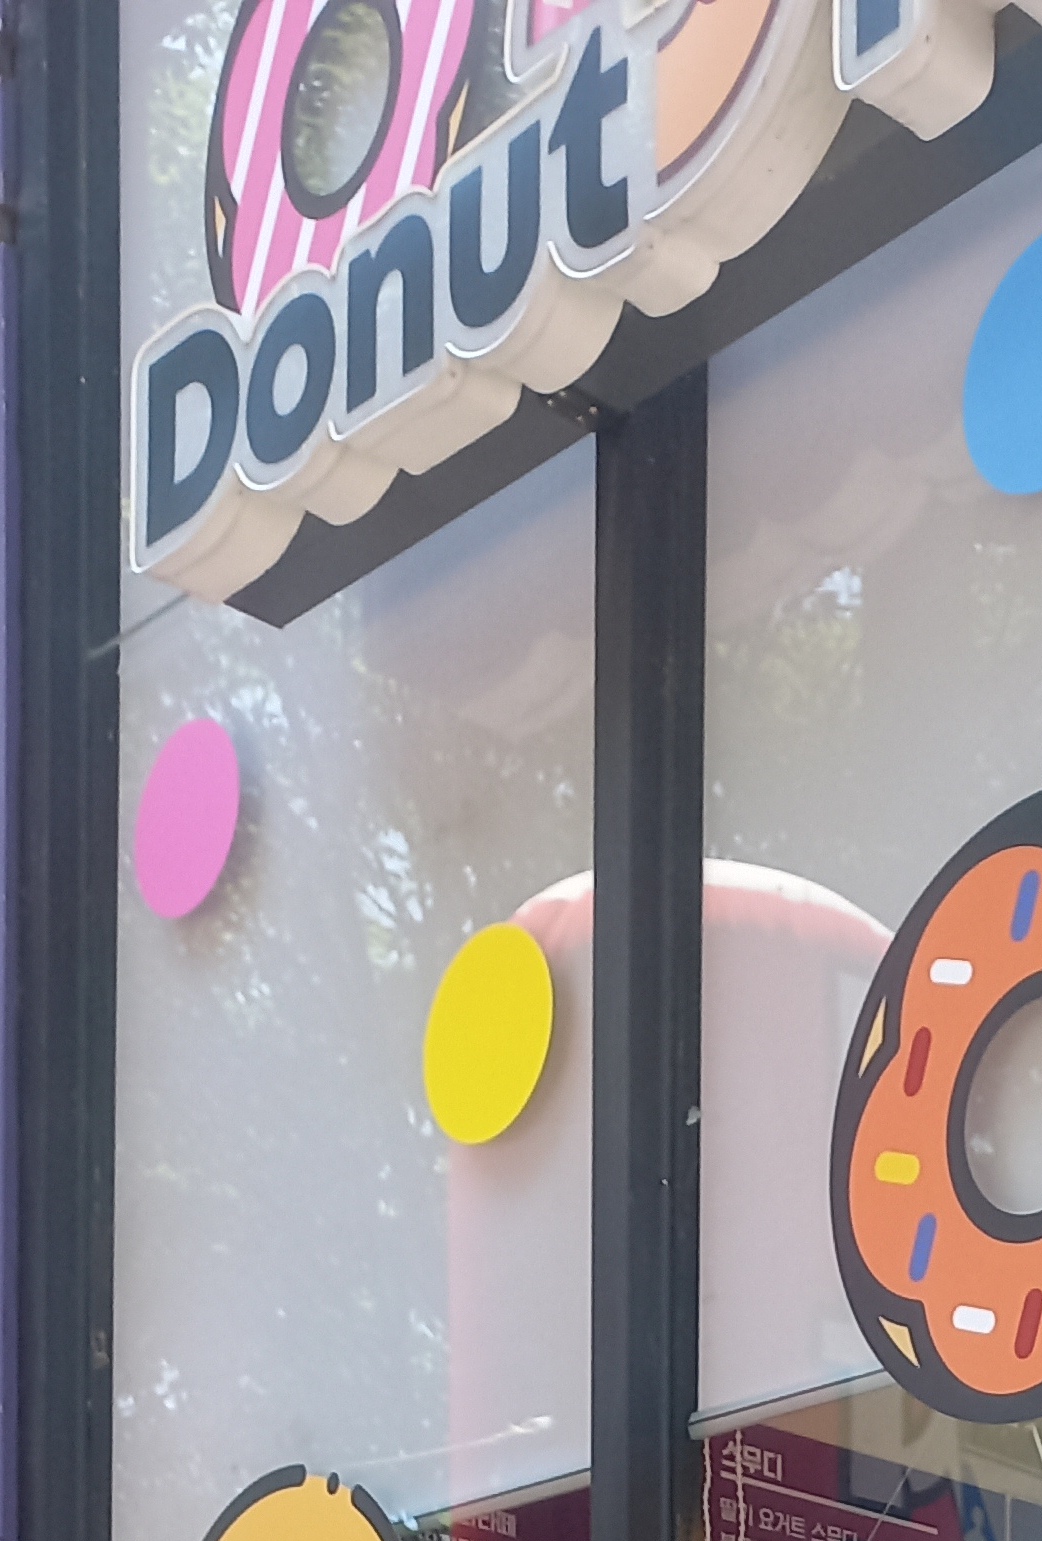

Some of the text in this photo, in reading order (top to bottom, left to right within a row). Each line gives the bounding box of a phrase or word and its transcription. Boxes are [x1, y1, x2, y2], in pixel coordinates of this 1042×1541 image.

[146, 25, 630, 548] Donut
[720, 1440, 783, 1482] 스무디
[462, 1511, 517, 1538] 라떼
[758, 1507, 806, 1539] 요거트
